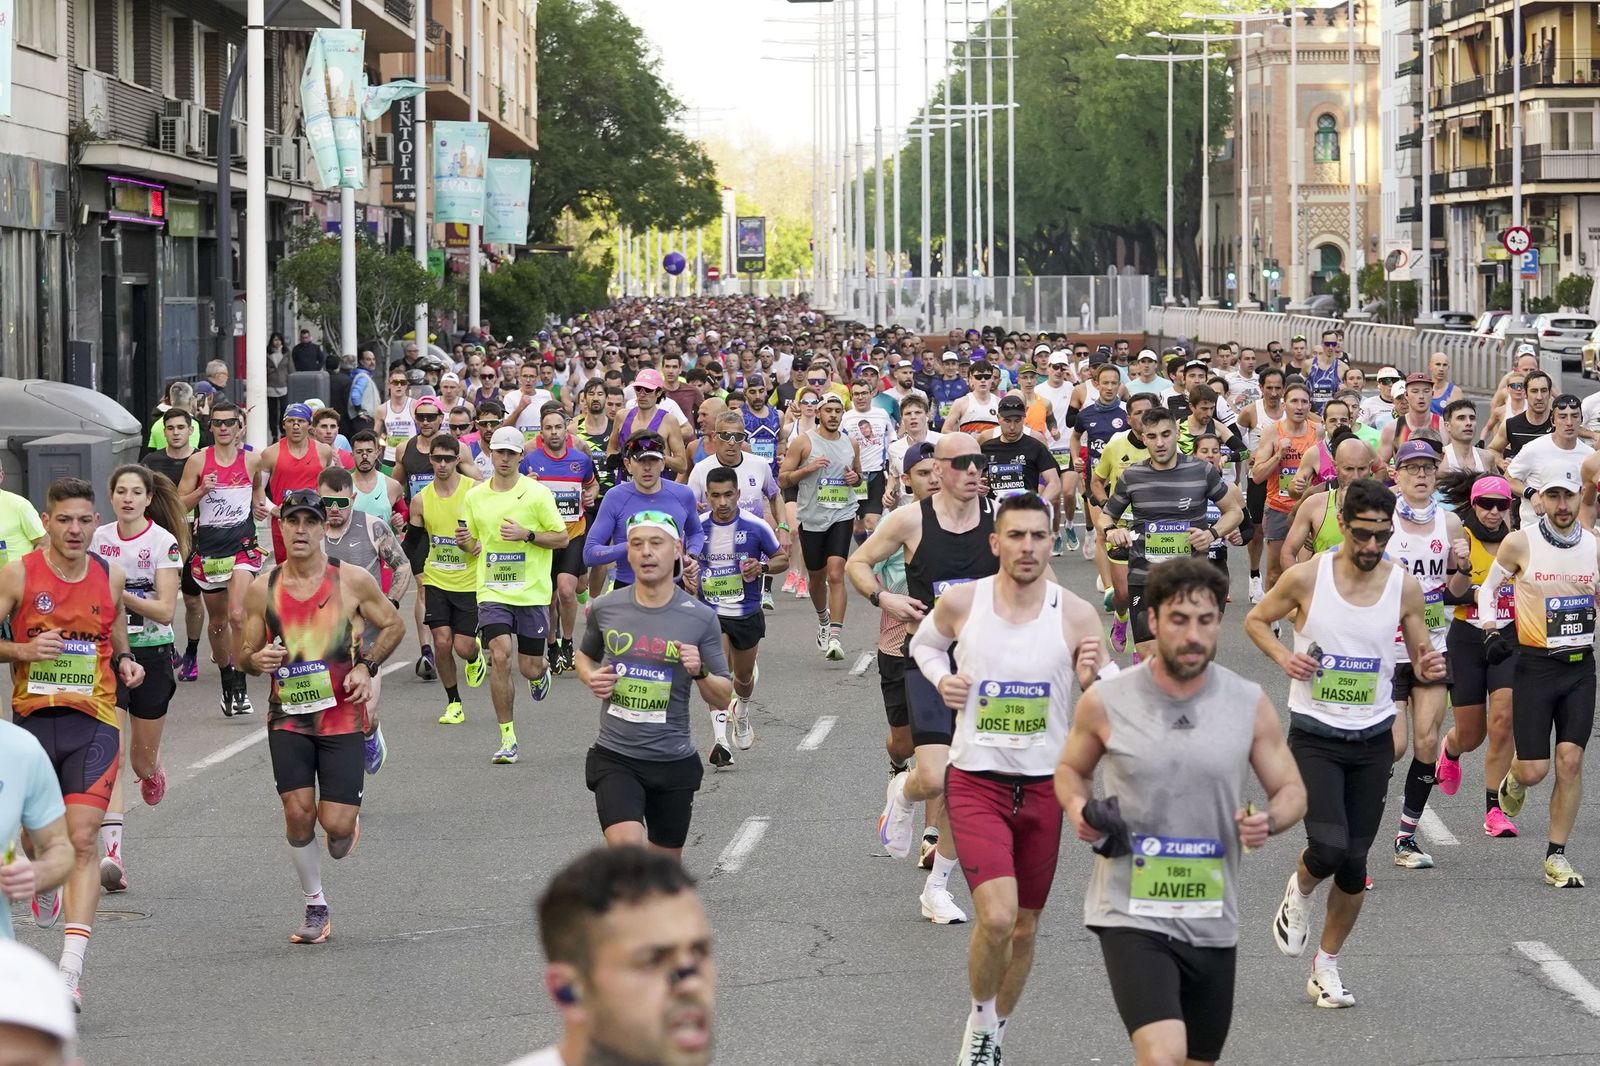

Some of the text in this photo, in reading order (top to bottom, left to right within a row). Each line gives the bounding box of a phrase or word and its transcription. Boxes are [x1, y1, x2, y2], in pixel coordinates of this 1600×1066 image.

[1521, 252, 1533, 269] P
[558, 506, 575, 515] ORÁN
[441, 537, 457, 545] ZURIC
[1146, 546, 1177, 554] ENRIQUE
[437, 554, 460, 563] VICTOR
[1563, 598, 1589, 607] ZURICH
[1560, 623, 1583, 635] FRED
[53, 659, 72, 668] 3251
[291, 662, 321, 675] ZURICH
[1338, 659, 1374, 670] ZURICH
[29, 671, 94, 685] JUAN PEDRO
[629, 667, 665, 680] ZURICH
[295, 680, 311, 689] 2433
[1338, 677, 1358, 687] 2597
[627, 684, 648, 694] 2719
[1004, 685, 1042, 695] ZURICH
[1321, 687, 1368, 702] HASSAN
[290, 689, 321, 703] COTRI
[1004, 704, 1025, 715] 3188
[976, 717, 1047, 732] JOSE MESA
[1165, 842, 1216, 855] ZURICH
[1166, 866, 1192, 878] 1881
[1148, 881, 1206, 898] JAVIER
